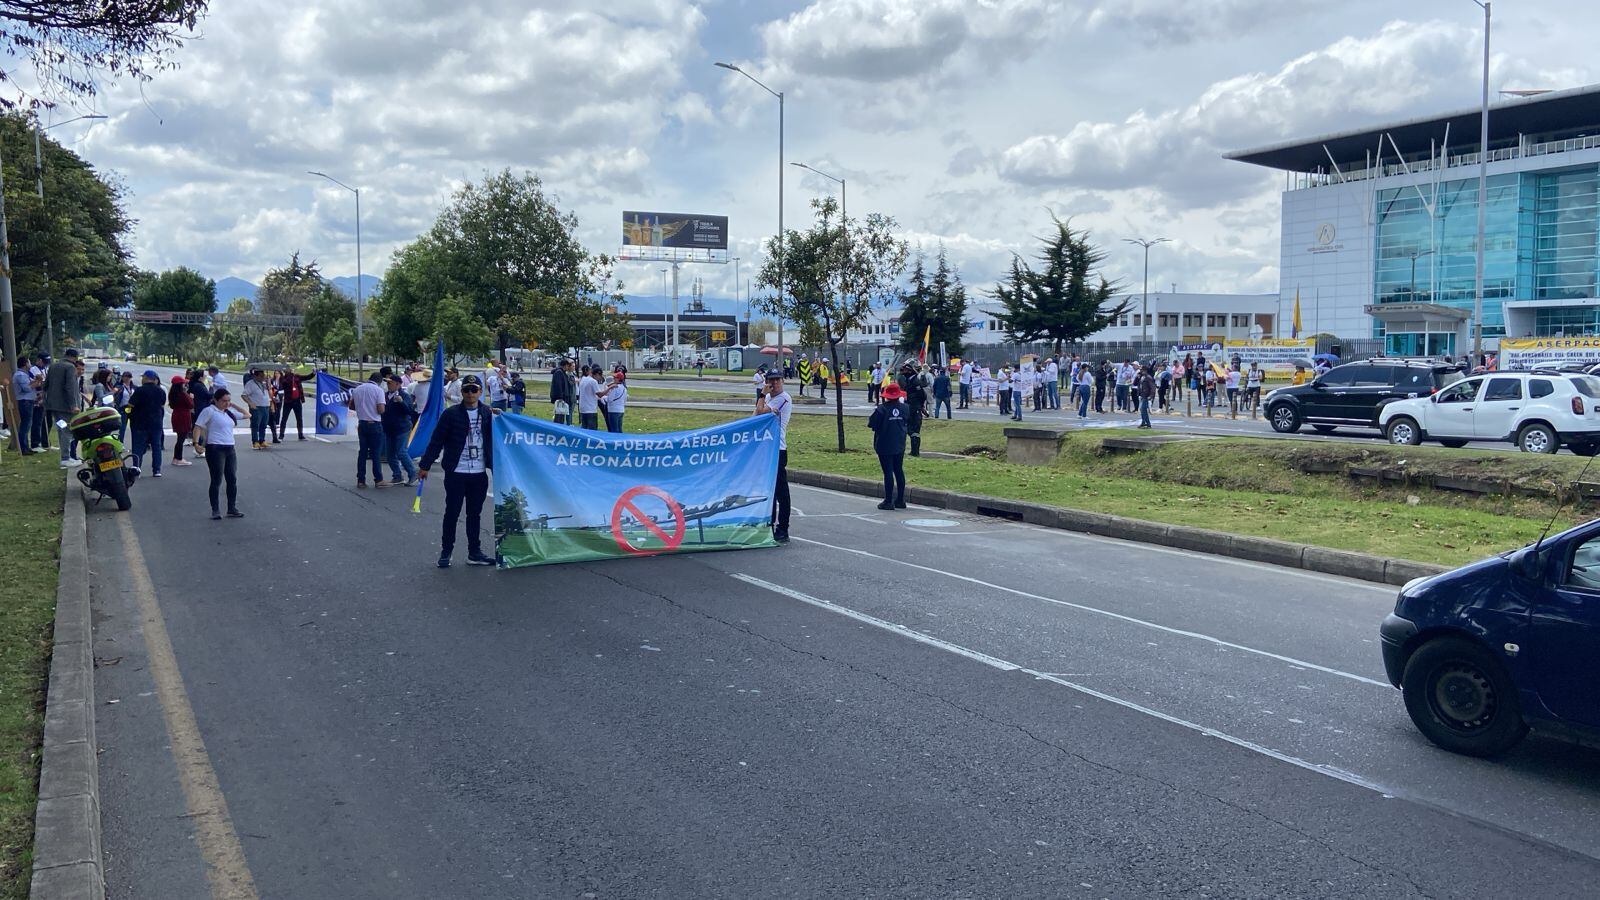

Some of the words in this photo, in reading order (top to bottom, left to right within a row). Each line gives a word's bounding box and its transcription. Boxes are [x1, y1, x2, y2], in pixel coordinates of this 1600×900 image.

[321, 392, 349, 405] Gran
[586, 437, 607, 450] LA
[614, 438, 674, 451] FUERZA
[680, 433, 727, 449] AÉREA
[731, 431, 750, 444] DE
[753, 429, 774, 442] LA
[556, 452, 683, 468] AERONÁUTICA
[689, 450, 729, 466] CIVIL
